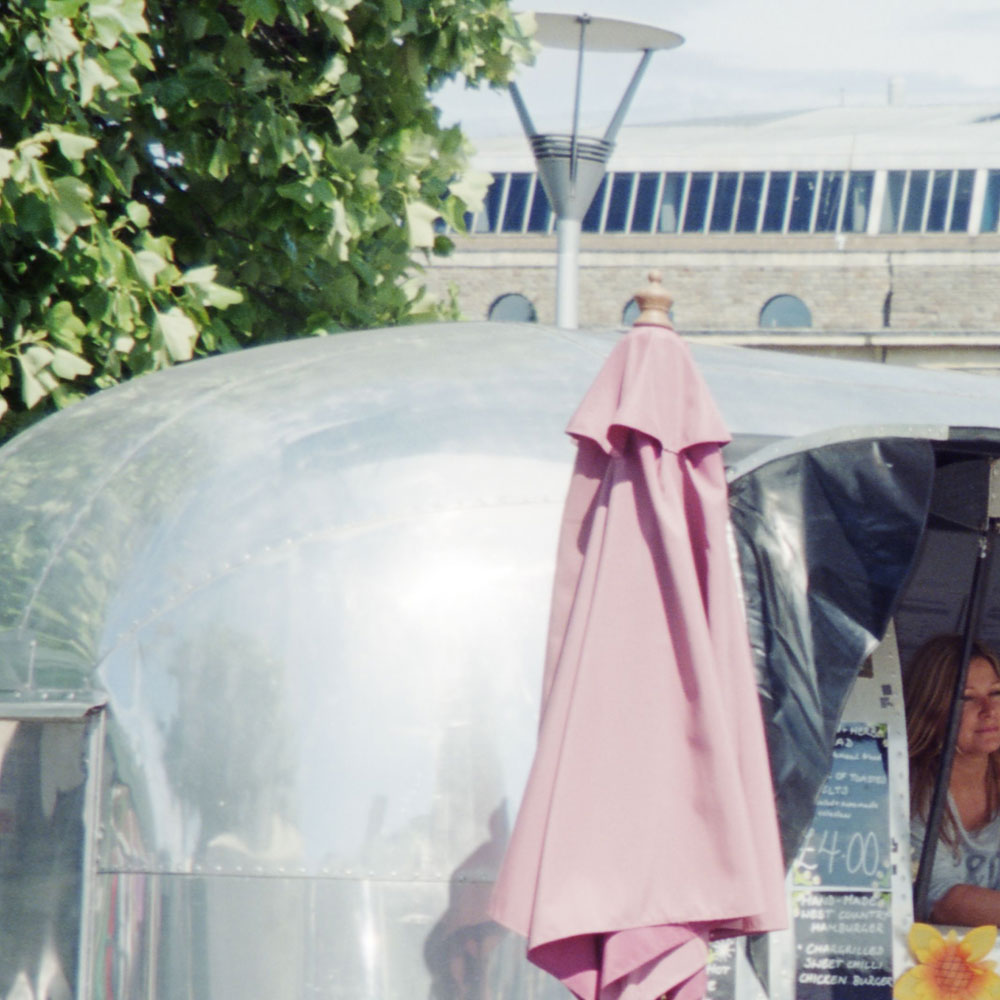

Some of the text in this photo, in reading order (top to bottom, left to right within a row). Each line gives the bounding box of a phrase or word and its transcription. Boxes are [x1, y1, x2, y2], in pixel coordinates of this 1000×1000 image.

[803, 956, 883, 970] SWEET CHILLI
[799, 972, 893, 987] CHICKEN BURGER
